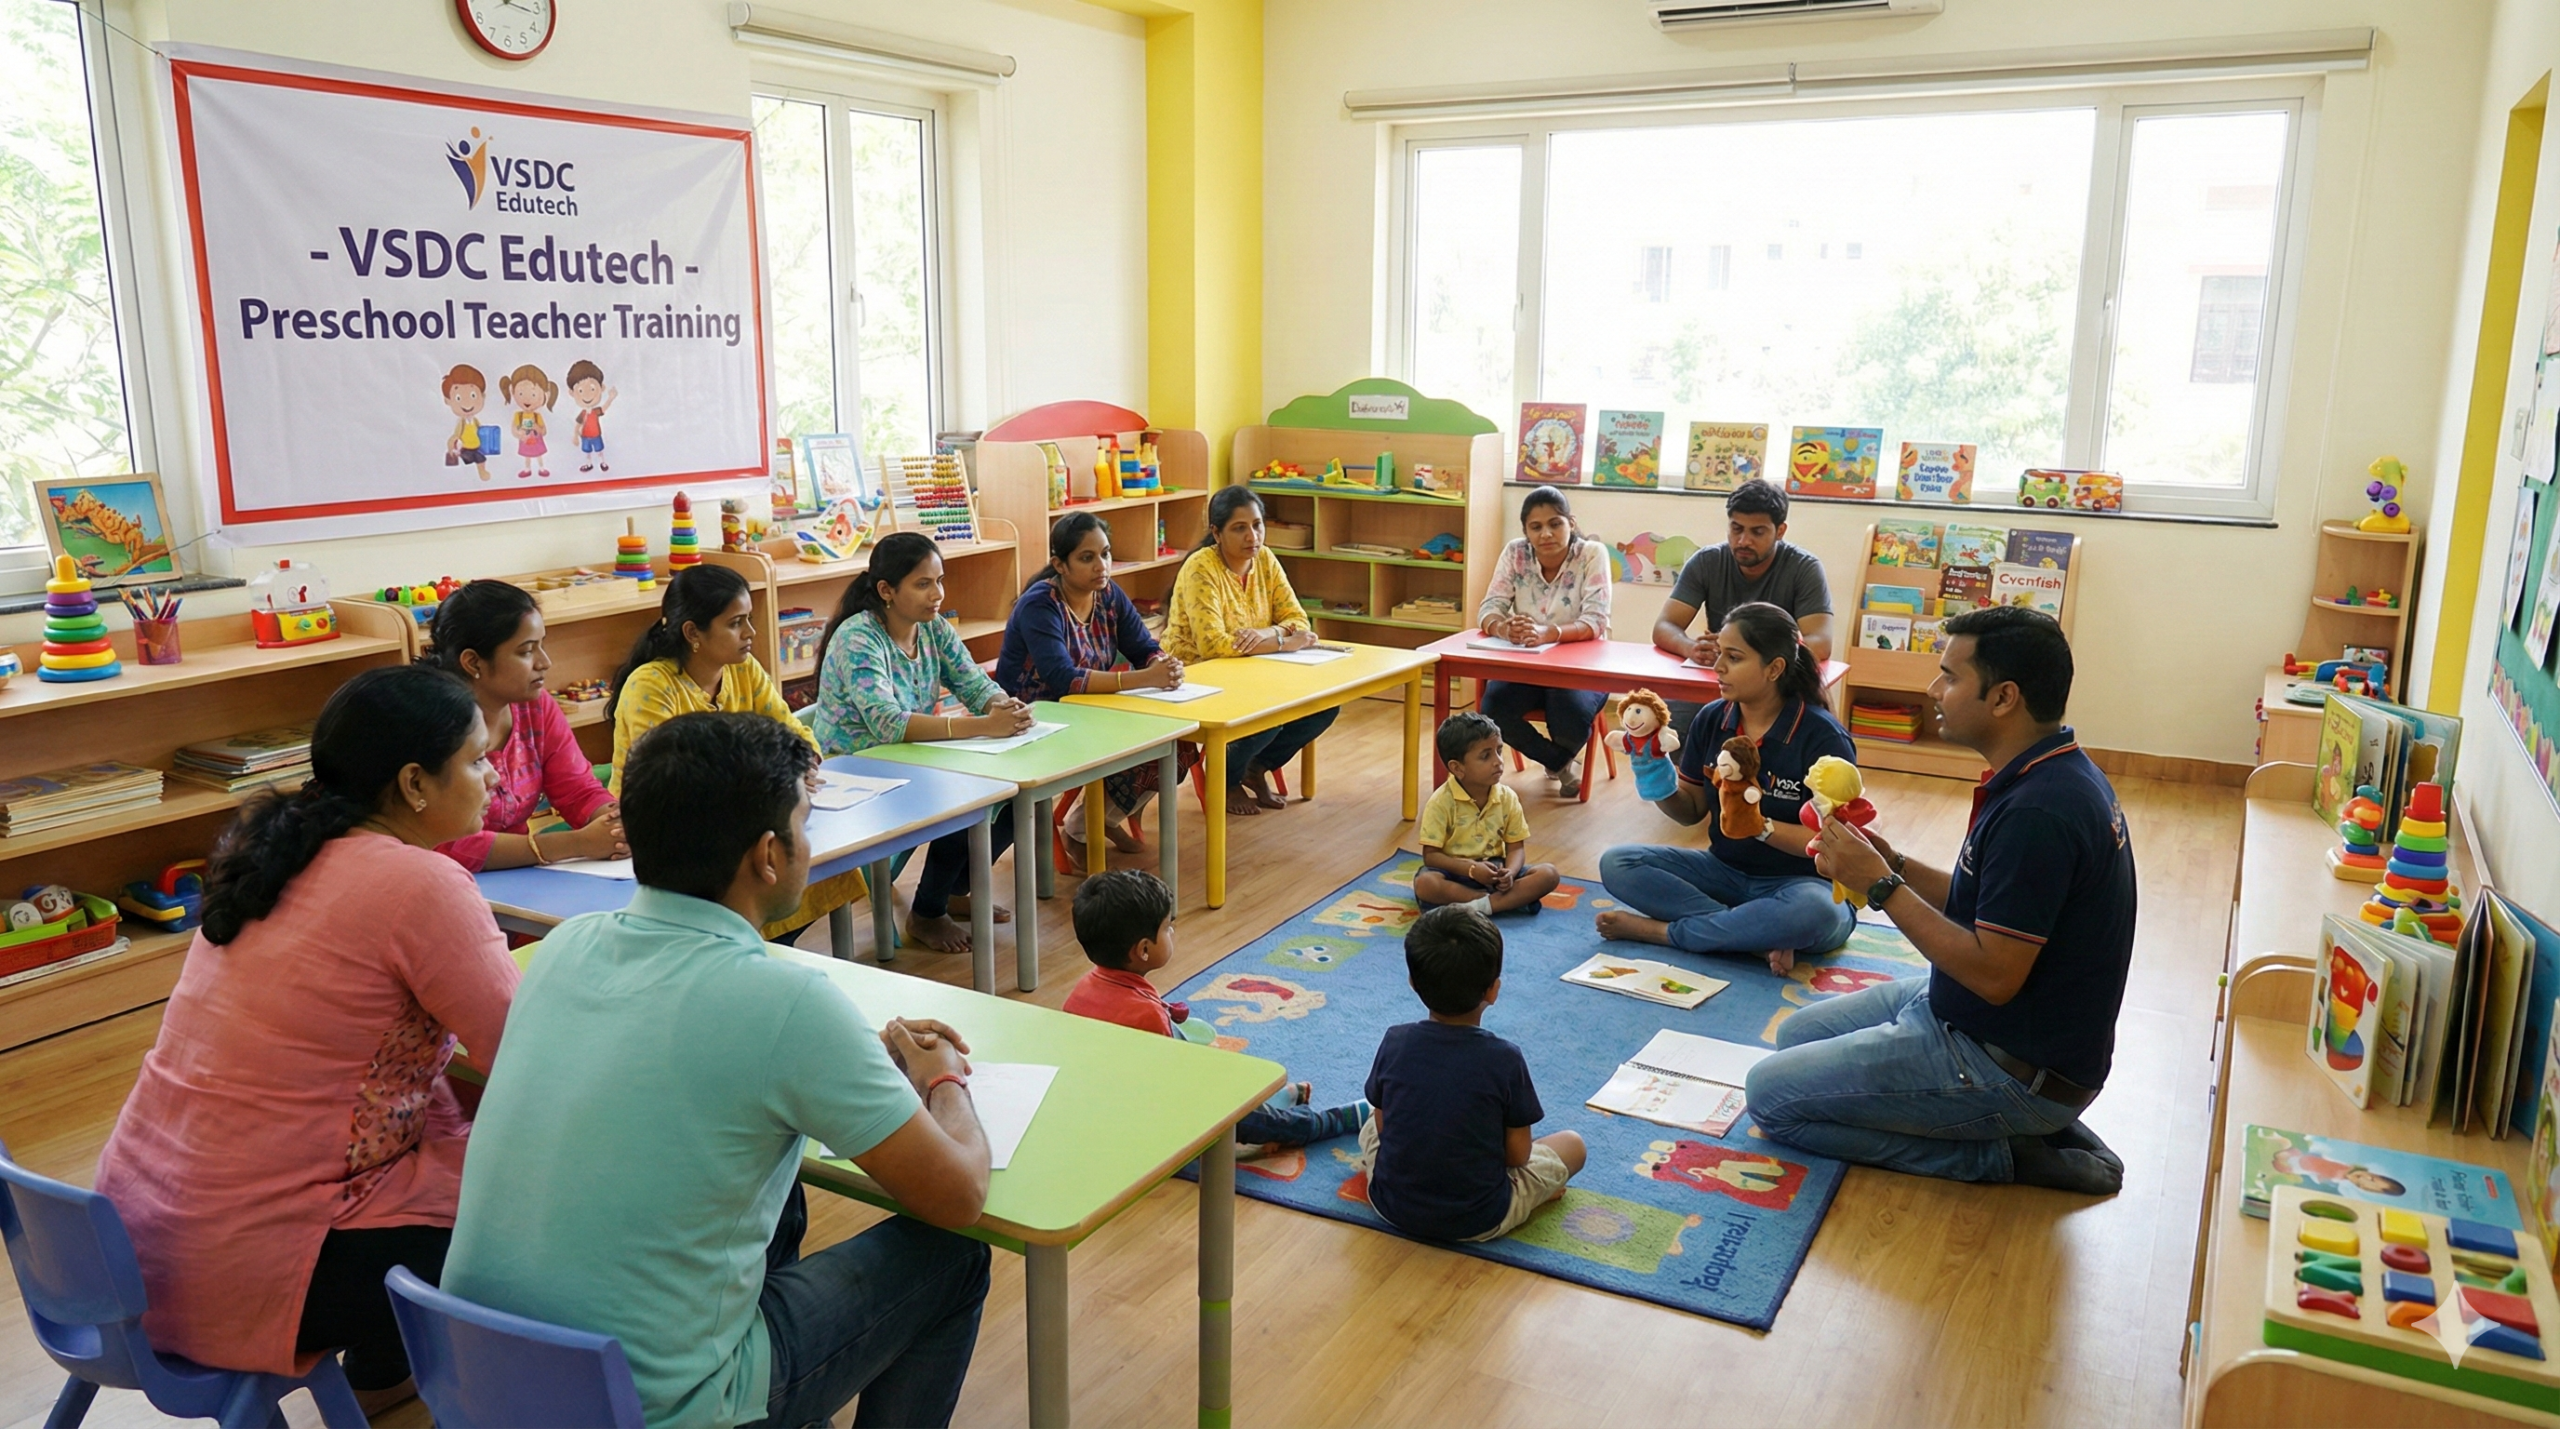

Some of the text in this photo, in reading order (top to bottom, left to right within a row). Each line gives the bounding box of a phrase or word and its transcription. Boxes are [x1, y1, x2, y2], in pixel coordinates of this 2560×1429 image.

[532, 2, 540, 15] 3
[489, 27, 496, 39] 7
[529, 21, 537, 33] 4
[504, 35, 512, 47] 6
[519, 32, 528, 44] 5
[490, 155, 575, 192] VSDC
[496, 190, 578, 217] Edutech
[338, 226, 488, 280] VSDC
[500, 234, 674, 285] Edutech
[240, 298, 741, 347] Preschool Teacher Training
